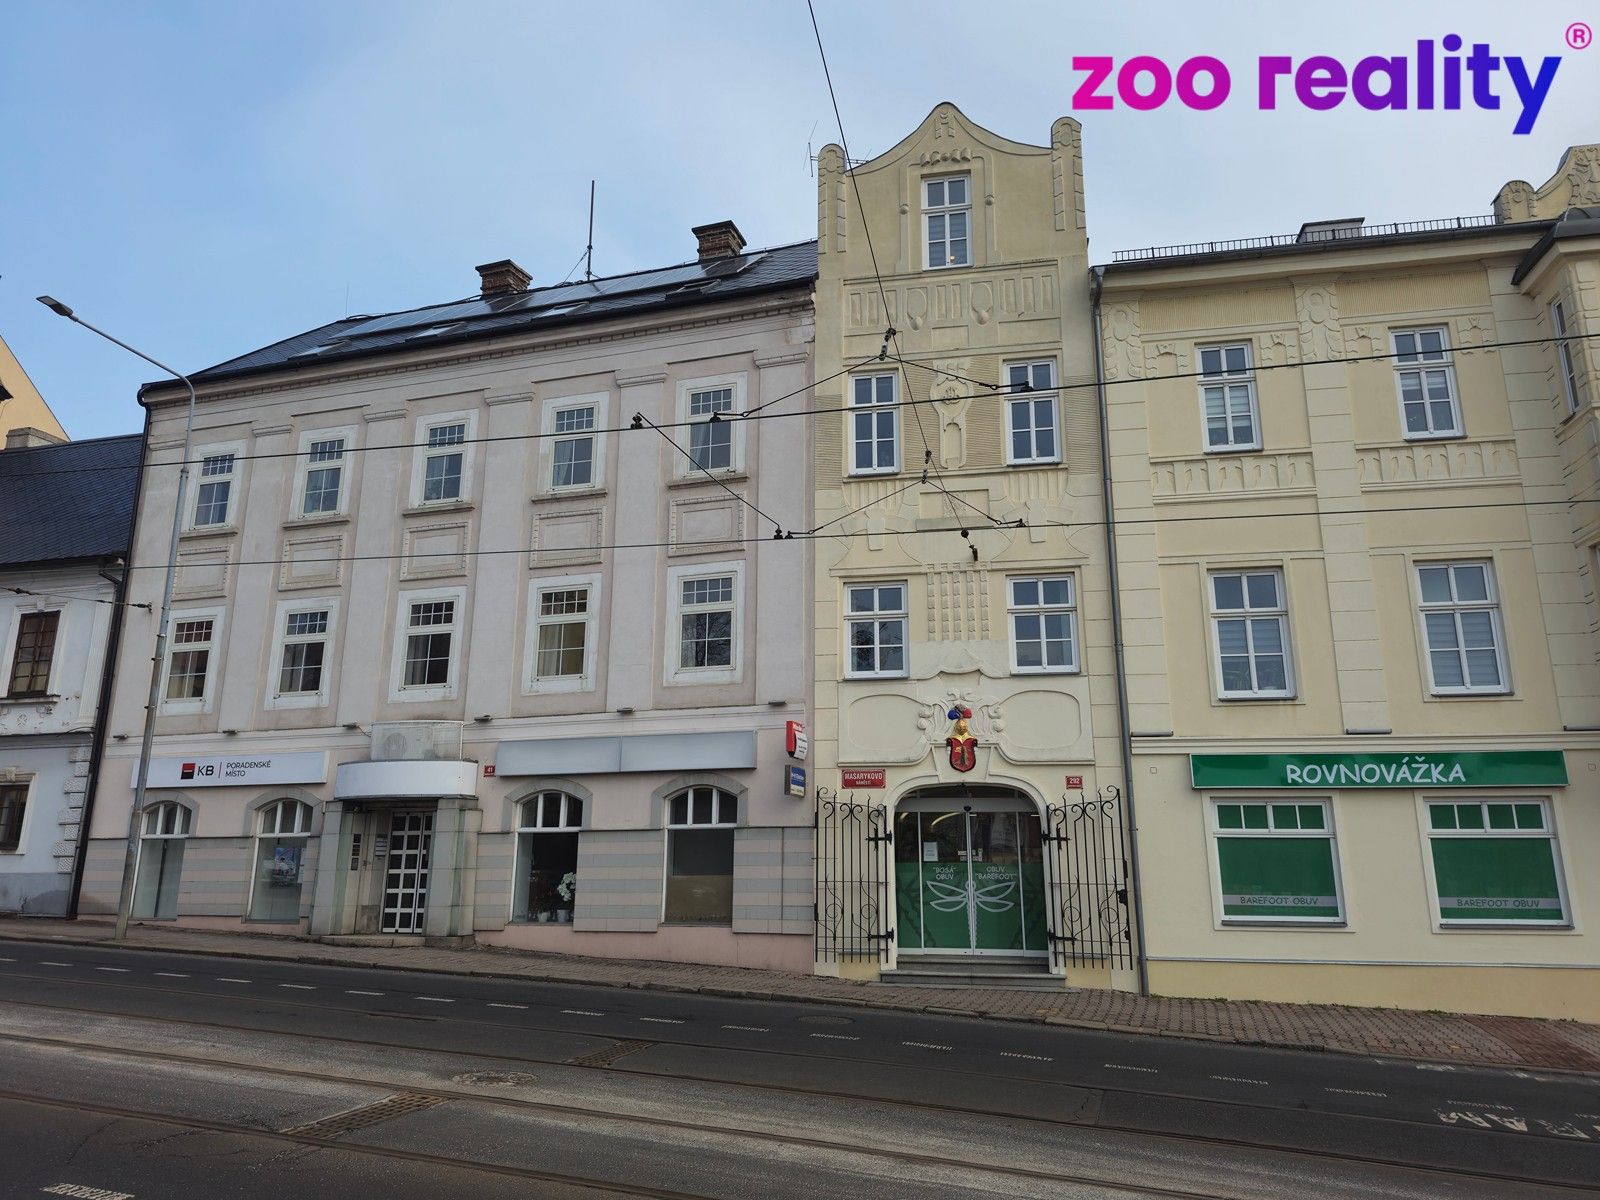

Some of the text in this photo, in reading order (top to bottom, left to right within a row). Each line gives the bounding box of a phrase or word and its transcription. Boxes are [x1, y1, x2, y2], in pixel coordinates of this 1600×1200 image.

[226, 760, 271, 769] PORADENSKÉ
[197, 765, 215, 777] KB
[225, 769, 246, 777] MÍSTO
[1286, 755, 1466, 784] ROVNOVÁŽKA
[844, 772, 883, 780] MASARYKOVO
[1240, 896, 1319, 905] BAREFOOT OBUV
[1457, 899, 1540, 908] BAREFOOT OBUV
